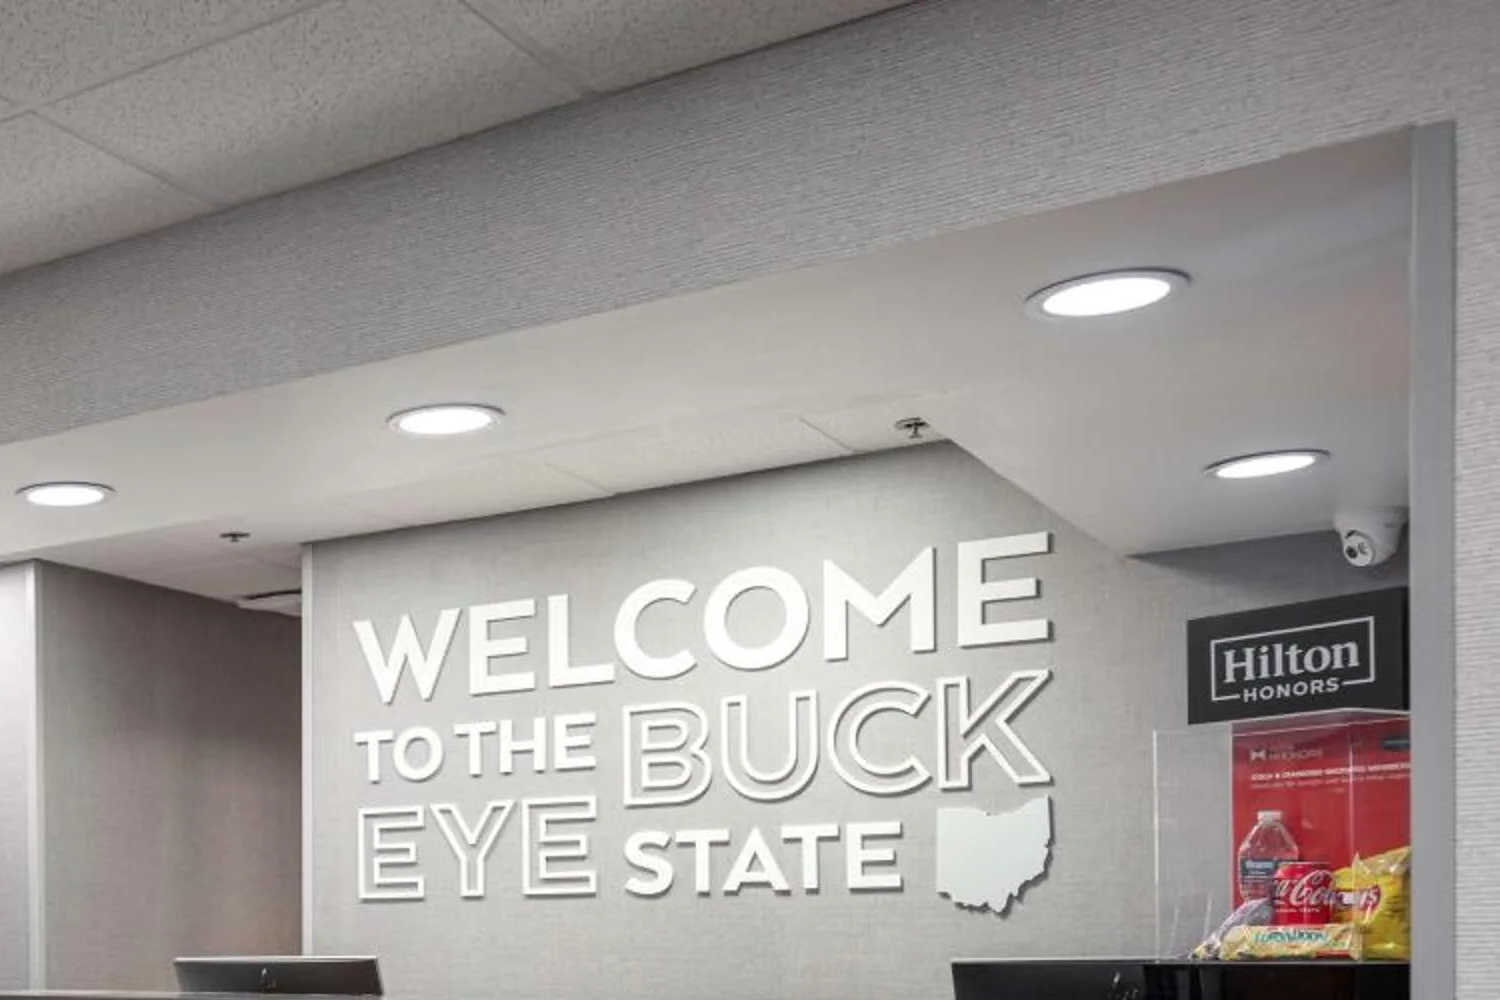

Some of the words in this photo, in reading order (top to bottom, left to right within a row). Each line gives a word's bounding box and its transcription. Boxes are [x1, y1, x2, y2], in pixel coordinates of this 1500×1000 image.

[353, 531, 1051, 705] WELCOME
[1223, 641, 1360, 683] Hilton
[355, 727, 443, 781] TO
[455, 713, 597, 777] THE
[623, 669, 1052, 809] BUCK
[1243, 677, 1340, 702] HONORS
[358, 796, 597, 901] EYE
[624, 821, 904, 896] STATE
